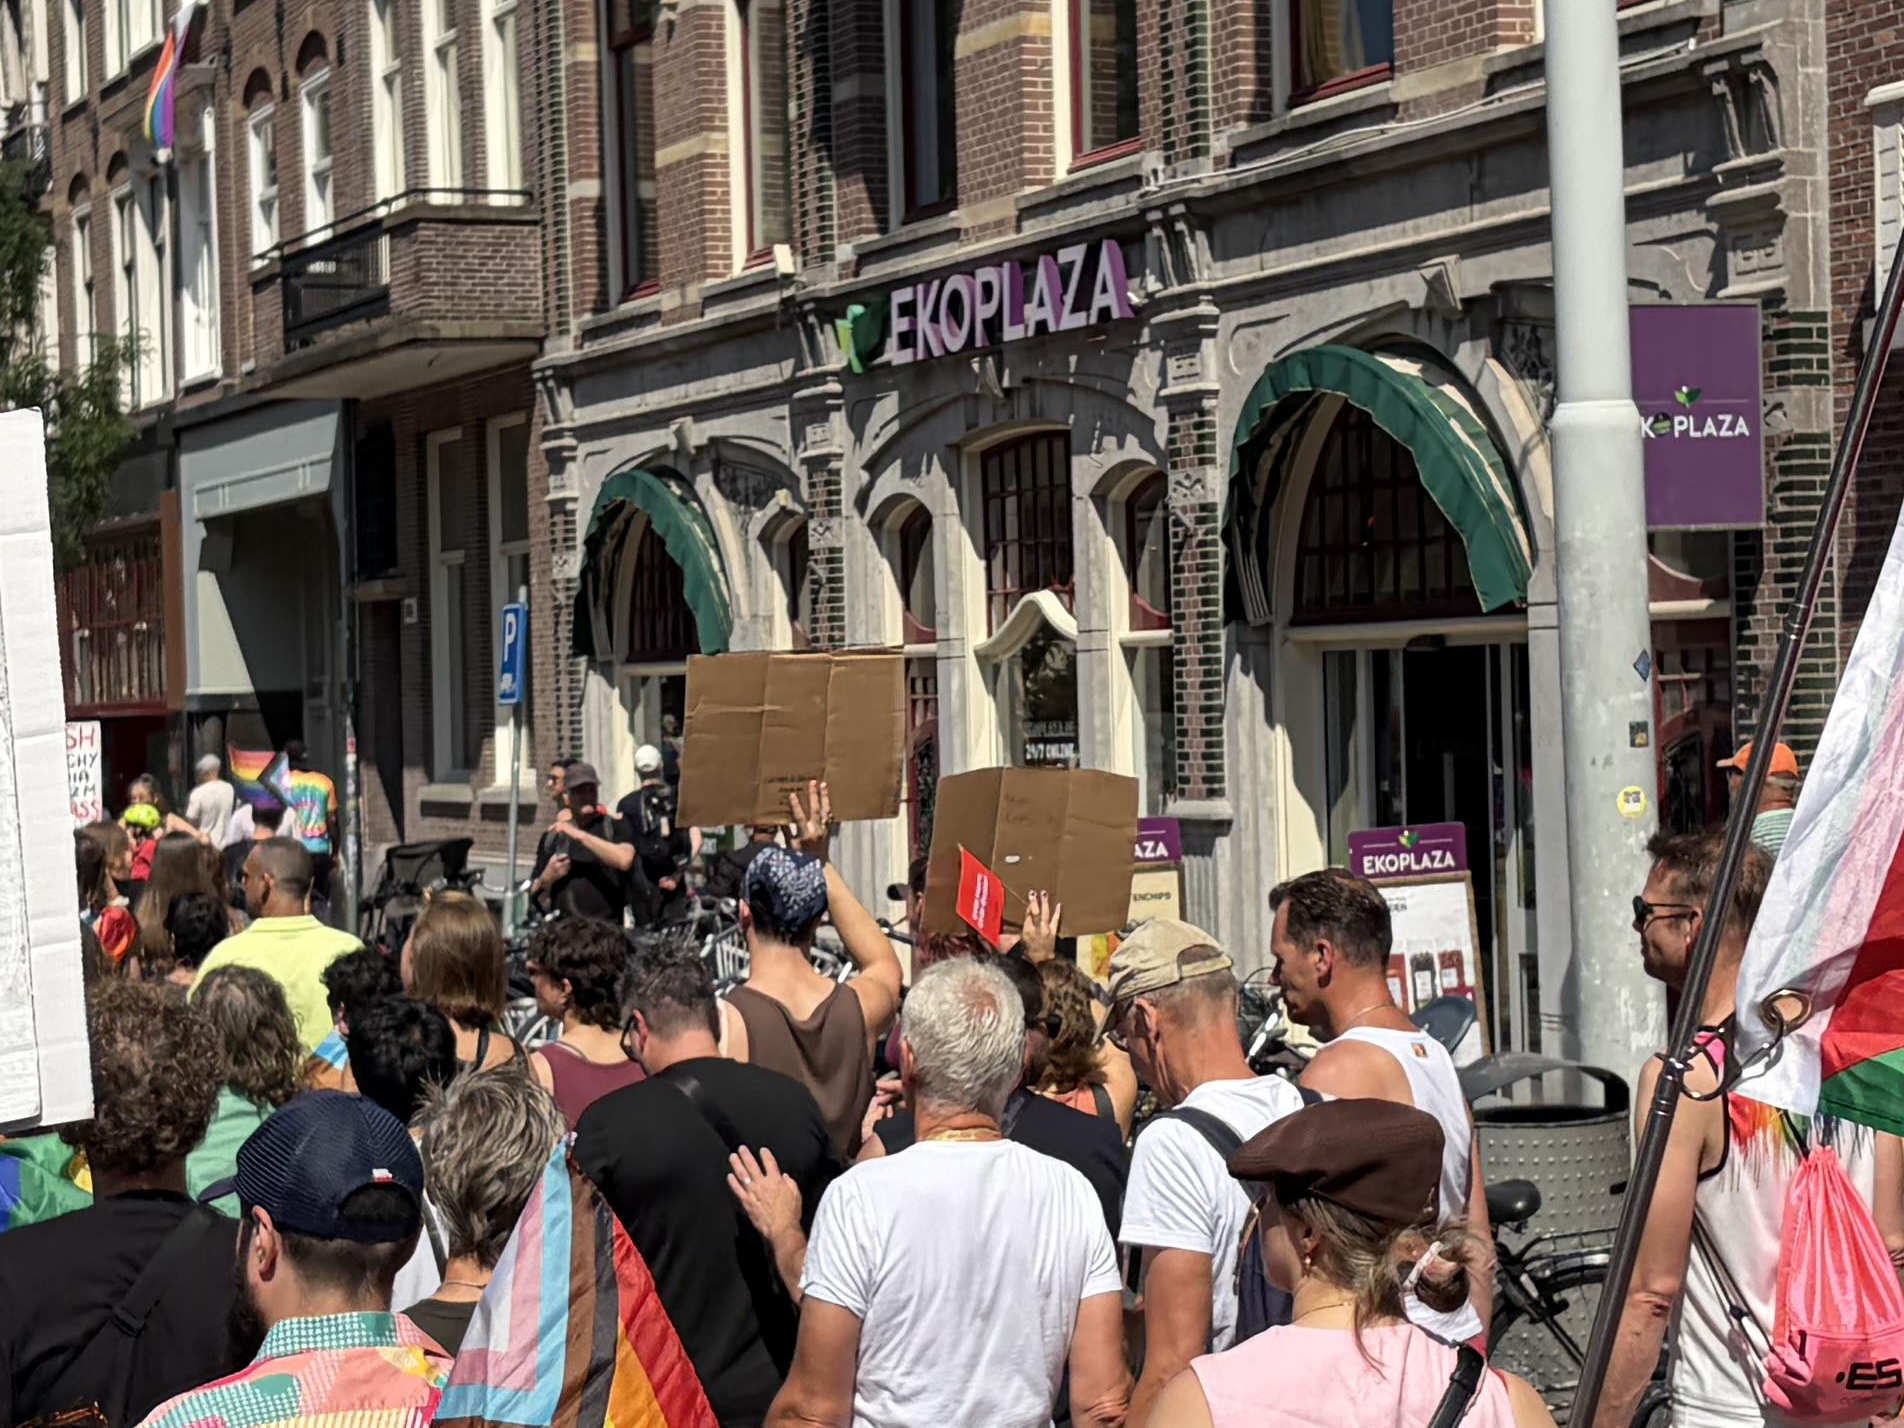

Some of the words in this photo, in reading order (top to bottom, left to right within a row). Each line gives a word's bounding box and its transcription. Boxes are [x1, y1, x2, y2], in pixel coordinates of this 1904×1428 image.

[890, 239, 1132, 366] EKOPLAZA
[504, 612, 517, 662] P
[1362, 849, 1456, 875] EKOPLAZA
